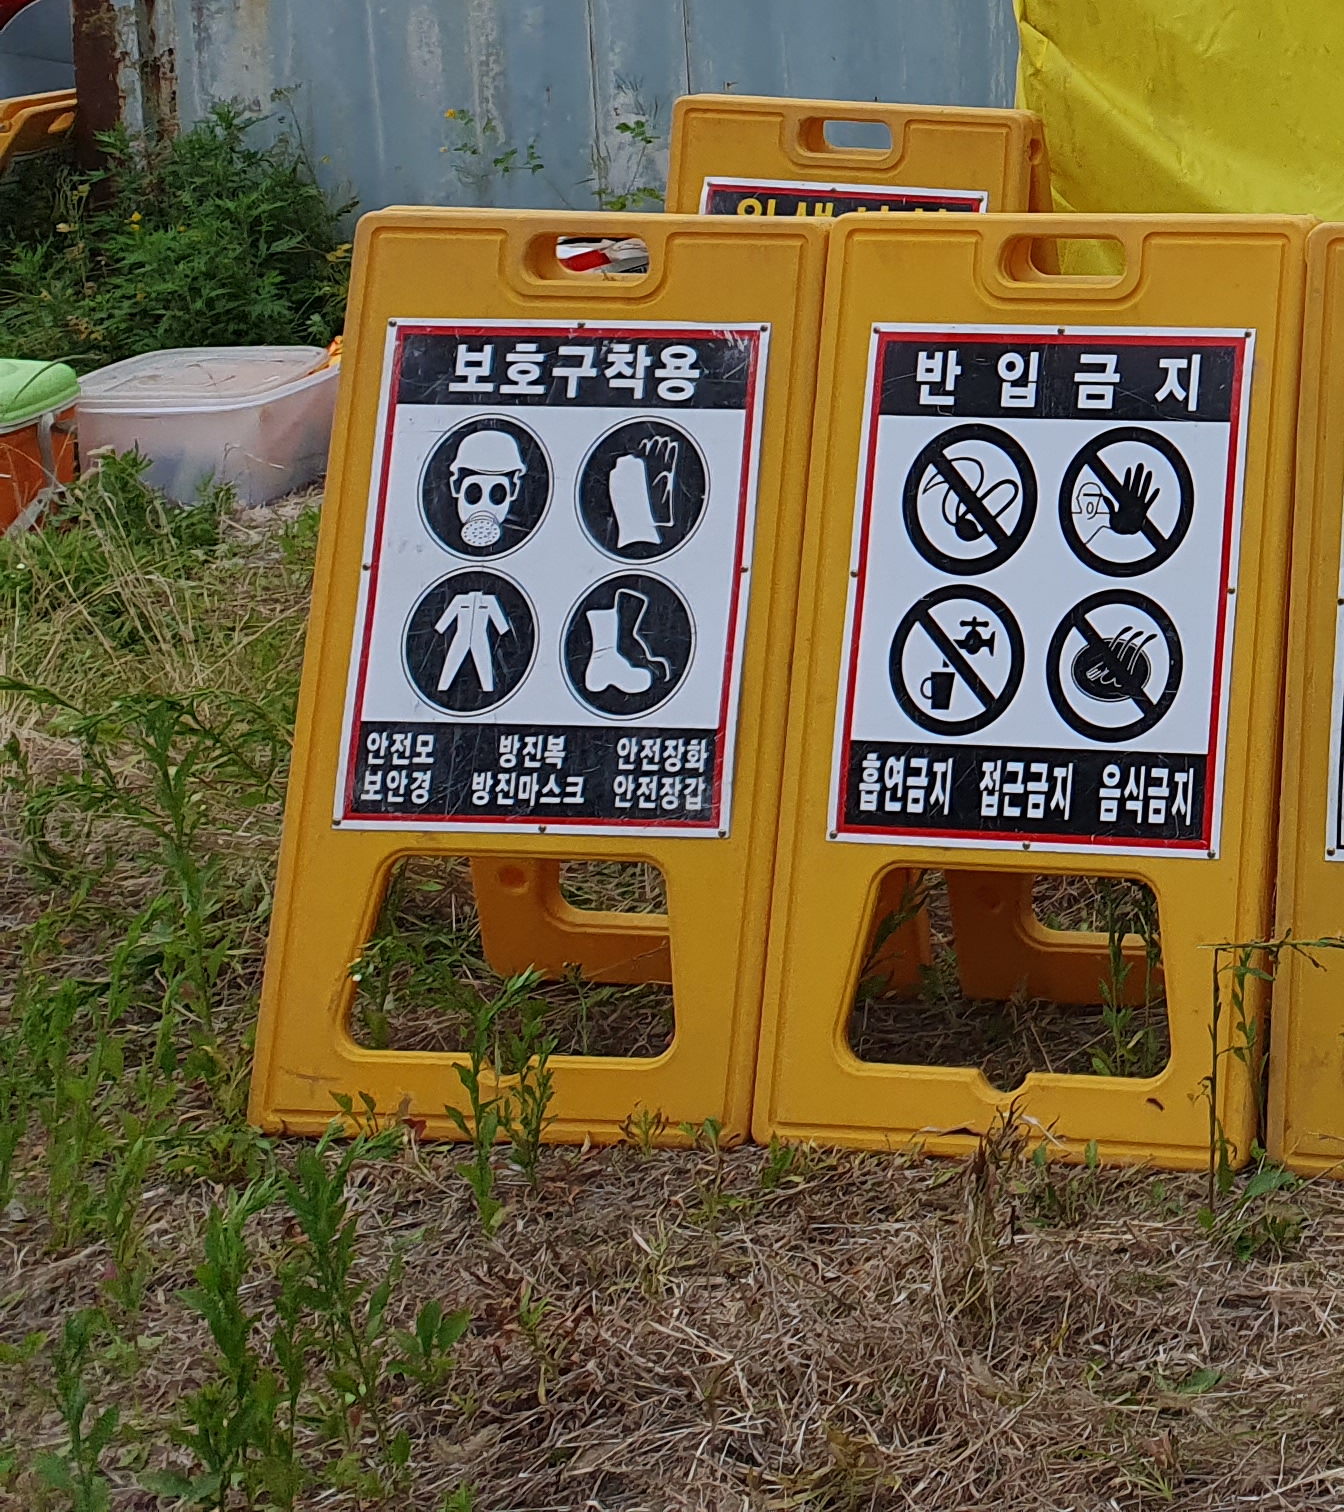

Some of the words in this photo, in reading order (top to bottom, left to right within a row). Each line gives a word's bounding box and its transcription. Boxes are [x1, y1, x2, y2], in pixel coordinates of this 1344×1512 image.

[448, 342, 699, 400] 보호구착용
[366, 731, 433, 765] 안전모
[498, 734, 565, 769] 방진복
[616, 737, 707, 772] 안전장화
[360, 769, 431, 803] 보안경
[471, 771, 584, 806] 방진마스크
[613, 774, 706, 810] 안전장갑
[858, 752, 953, 815] 흡연금지
[979, 759, 1073, 820] 접근금지
[1098, 764, 1193, 825] 음식금지
